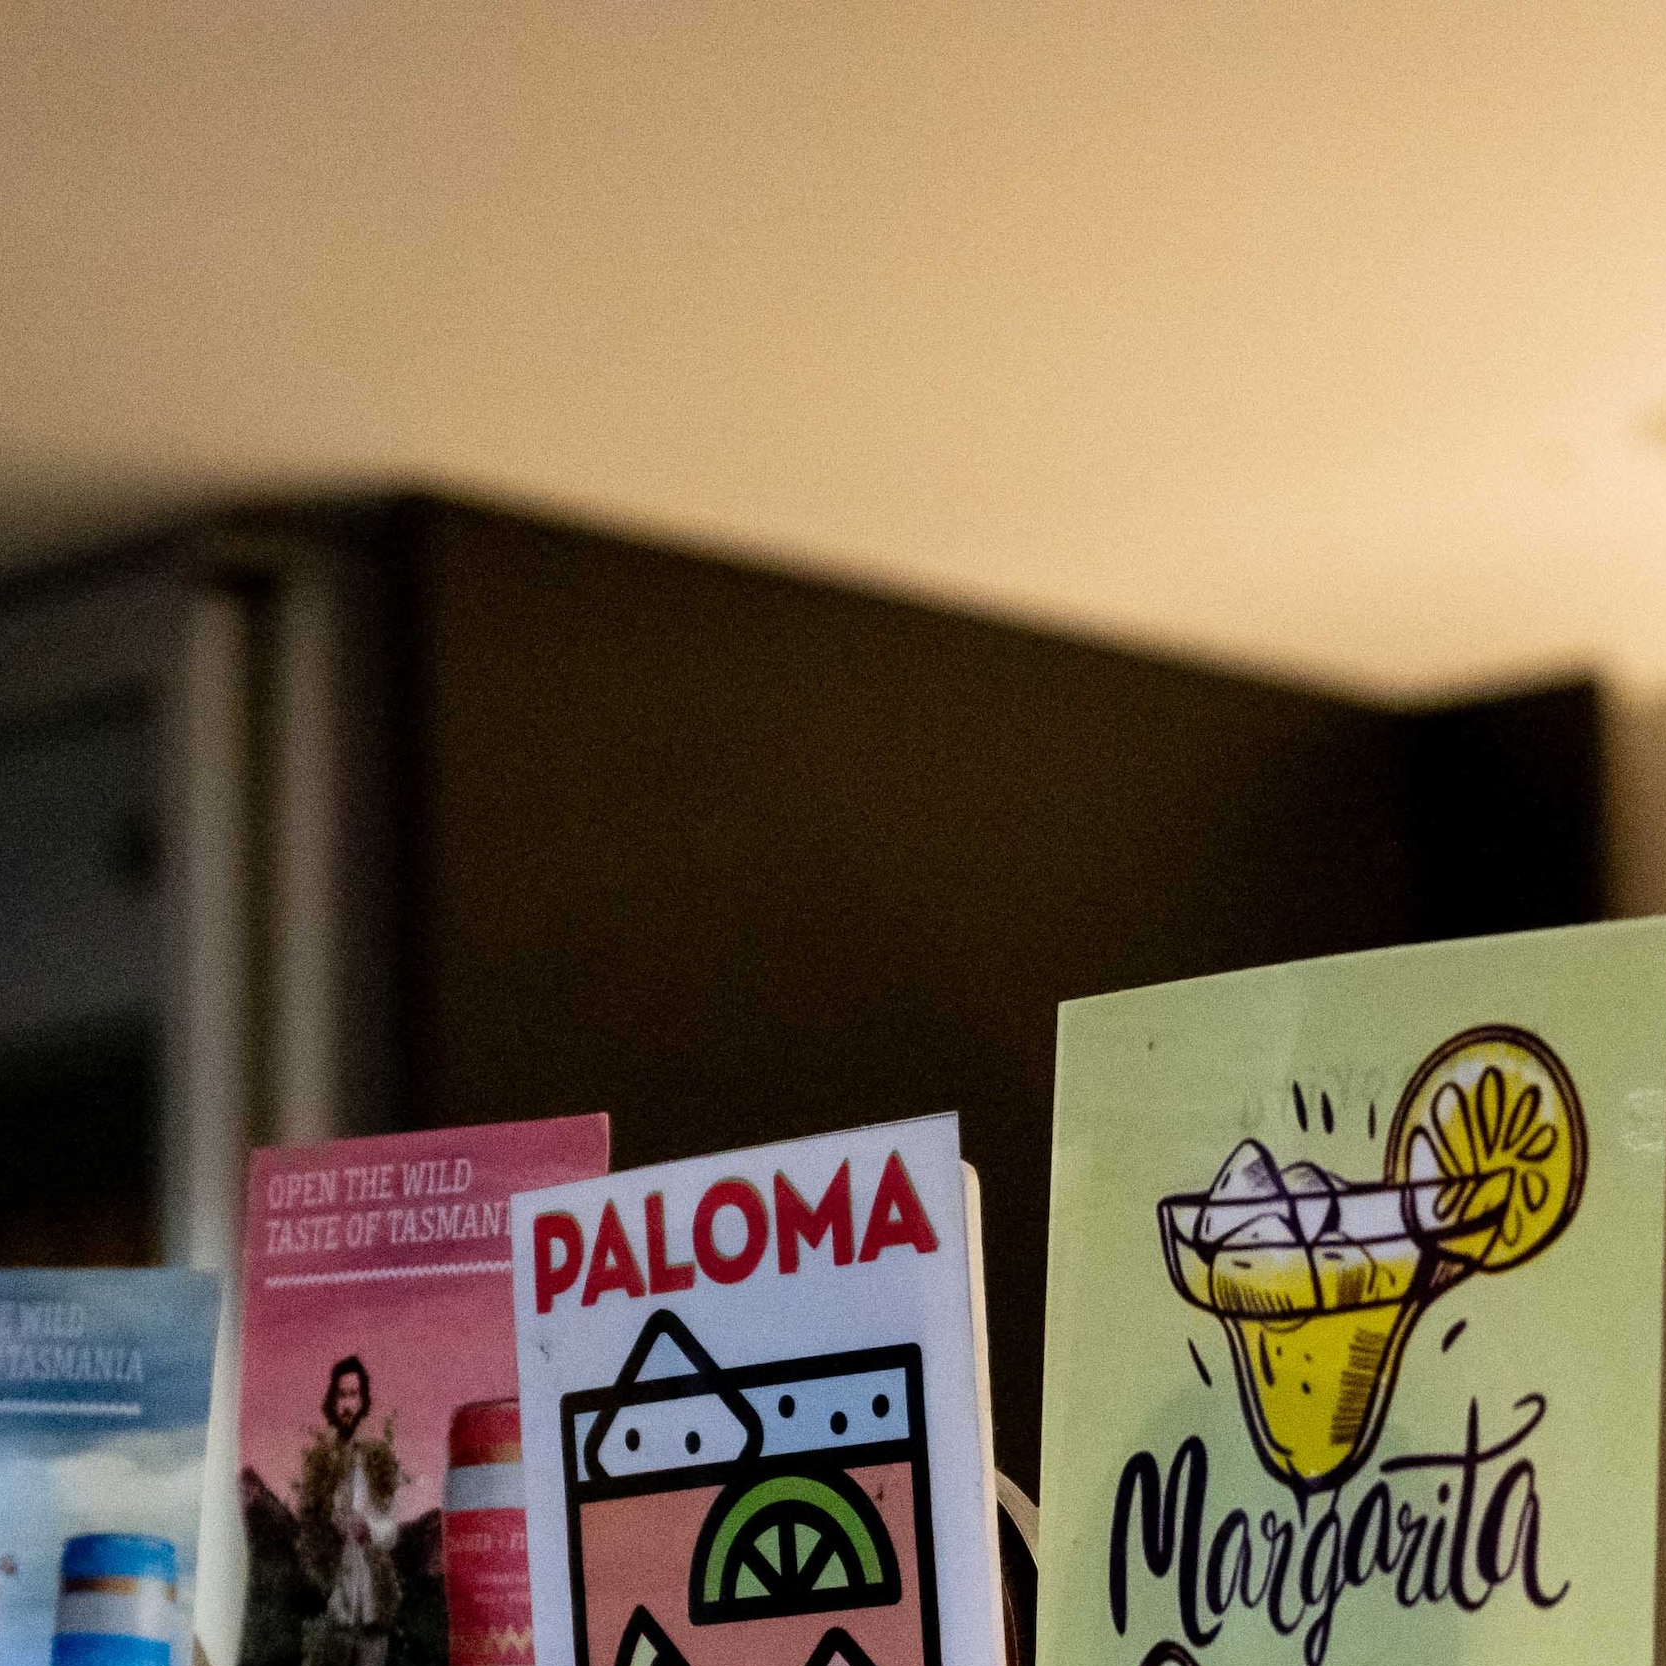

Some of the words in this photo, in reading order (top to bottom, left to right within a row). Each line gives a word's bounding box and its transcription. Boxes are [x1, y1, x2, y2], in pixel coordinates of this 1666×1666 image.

[268, 1170, 337, 1210] OPEN
[344, 1163, 395, 1202] THE
[401, 1158, 472, 1197] WILD
[266, 1215, 342, 1254] TASTE
[346, 1210, 382, 1248] OF
[533, 1149, 939, 1315] PALOMA
[19, 1303, 87, 1338] WILD
[5, 1345, 144, 1383] TASMANIA
